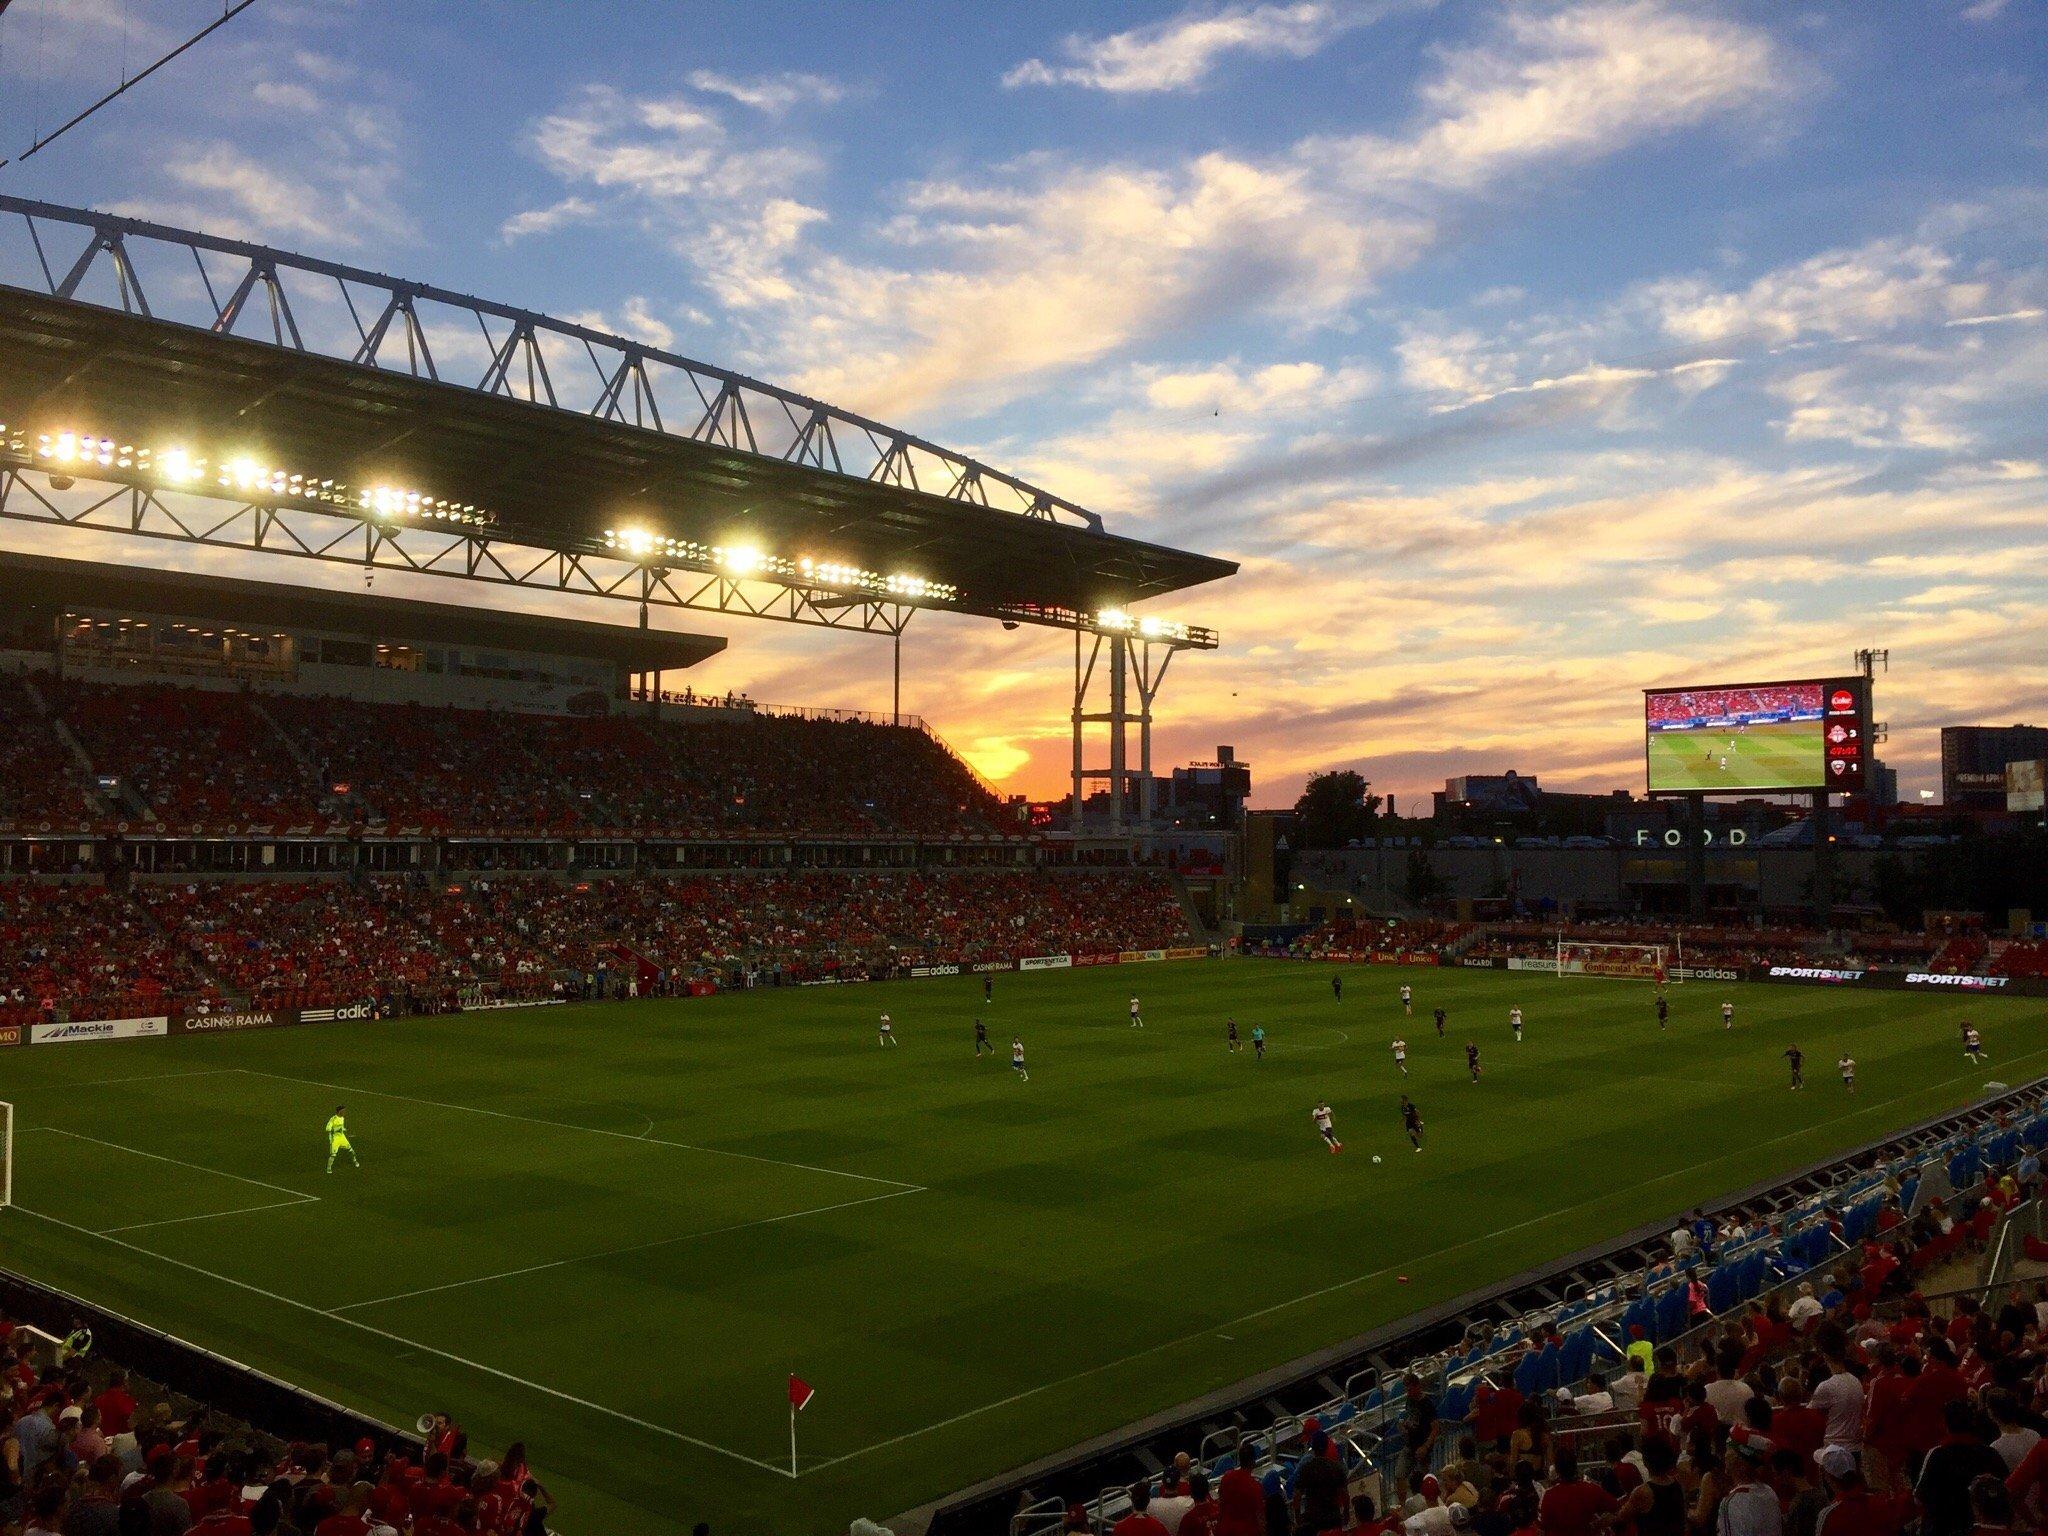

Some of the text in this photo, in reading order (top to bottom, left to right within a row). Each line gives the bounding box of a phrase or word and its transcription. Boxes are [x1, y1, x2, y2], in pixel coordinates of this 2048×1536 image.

[1849, 729, 1857, 738] 3
[1851, 763, 1857, 772] 1
[1409, 954, 1432, 963] Unico
[930, 964, 959, 976] adidas
[1696, 968, 1737, 980] adidas
[1769, 966, 1865, 980] SPORTSNET
[1905, 972, 2009, 987] SPORTSNET
[337, 1004, 390, 1020] adids
[186, 1013, 273, 1030] CASINO RAMA
[68, 1023, 114, 1034] Mackie
